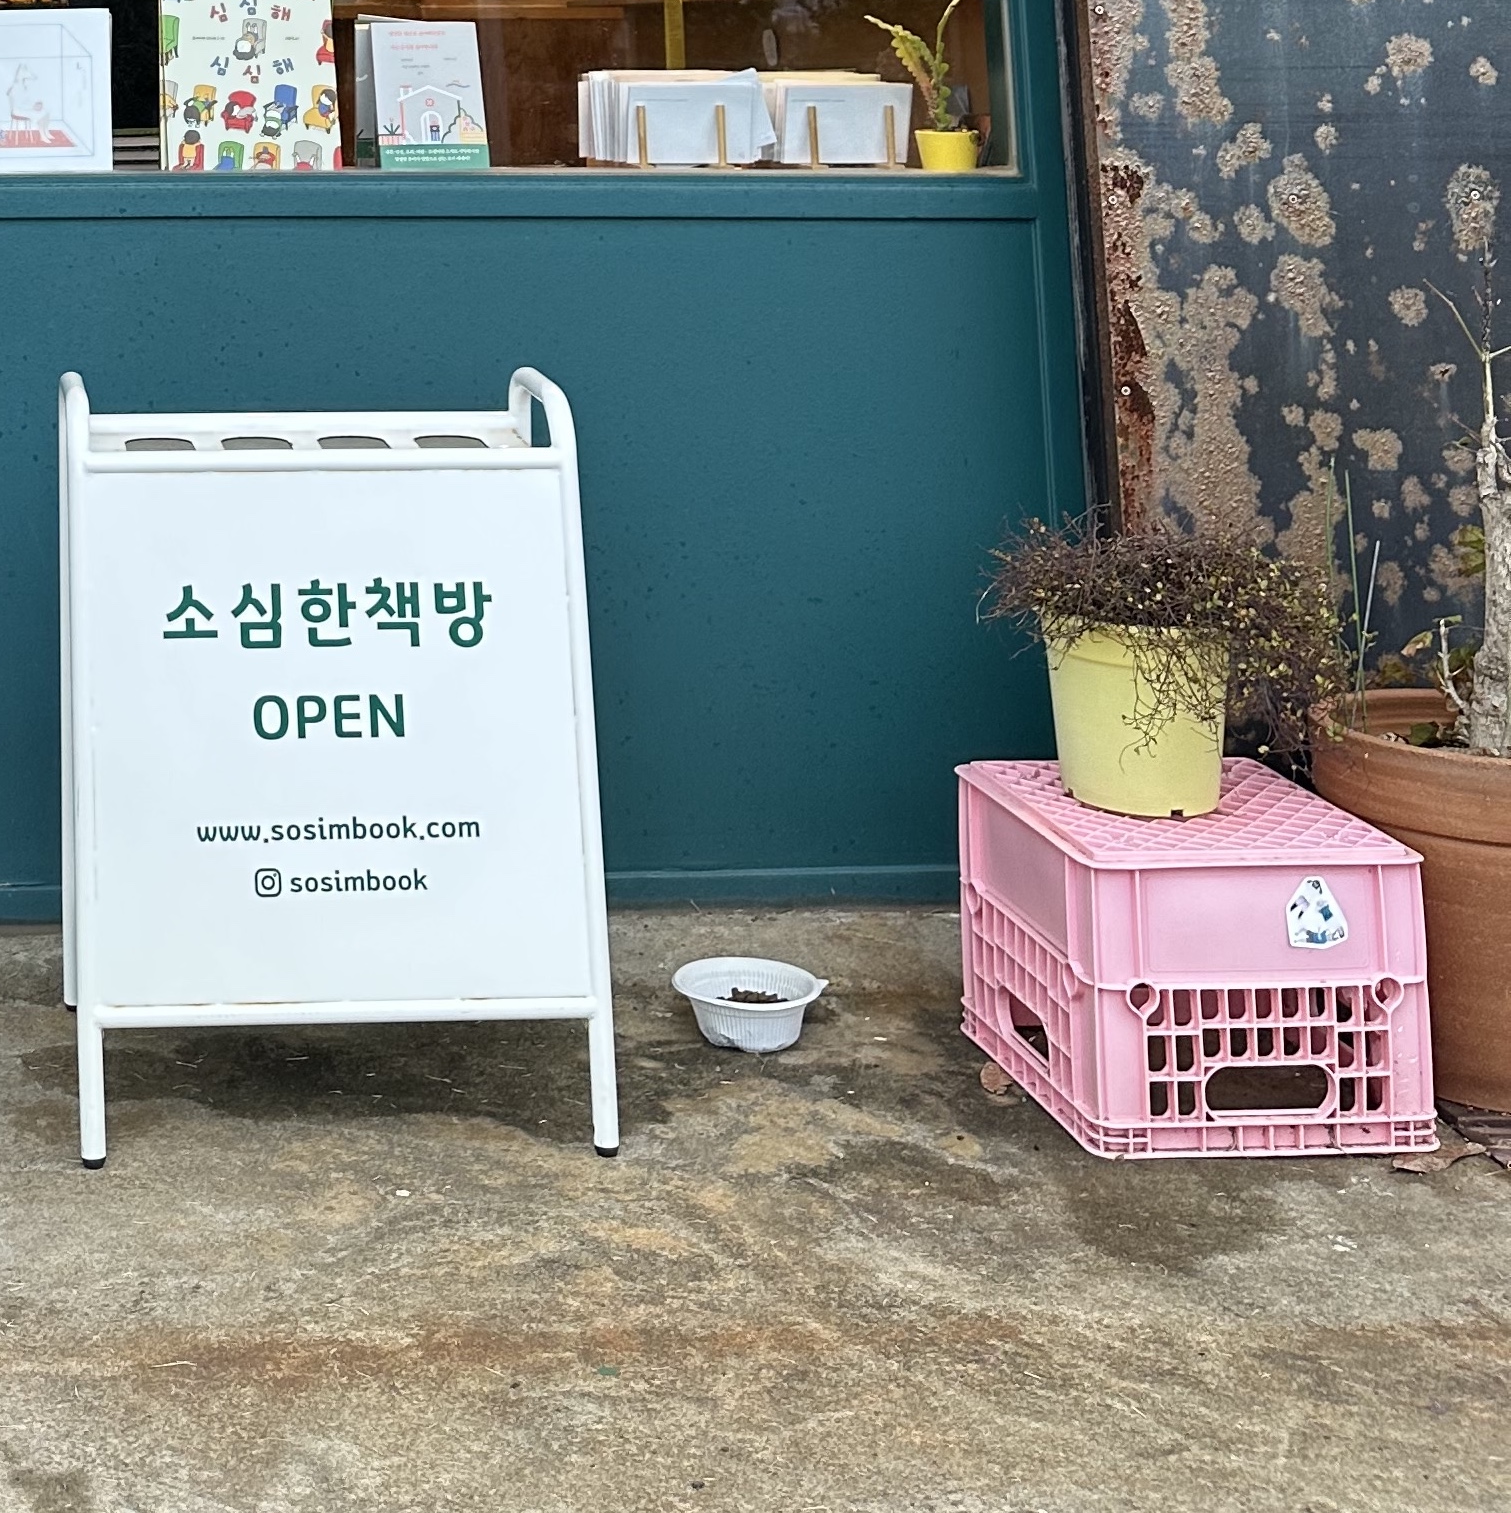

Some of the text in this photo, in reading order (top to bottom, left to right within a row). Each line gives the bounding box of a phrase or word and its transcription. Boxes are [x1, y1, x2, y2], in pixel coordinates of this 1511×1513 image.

[209, 56, 295, 84] 심심해
[163, 577, 492, 649] 소심한책방
[254, 694, 405, 740] OPEN
[196, 816, 481, 844] www.sosimbook.com
[291, 868, 428, 893] sosimbook
